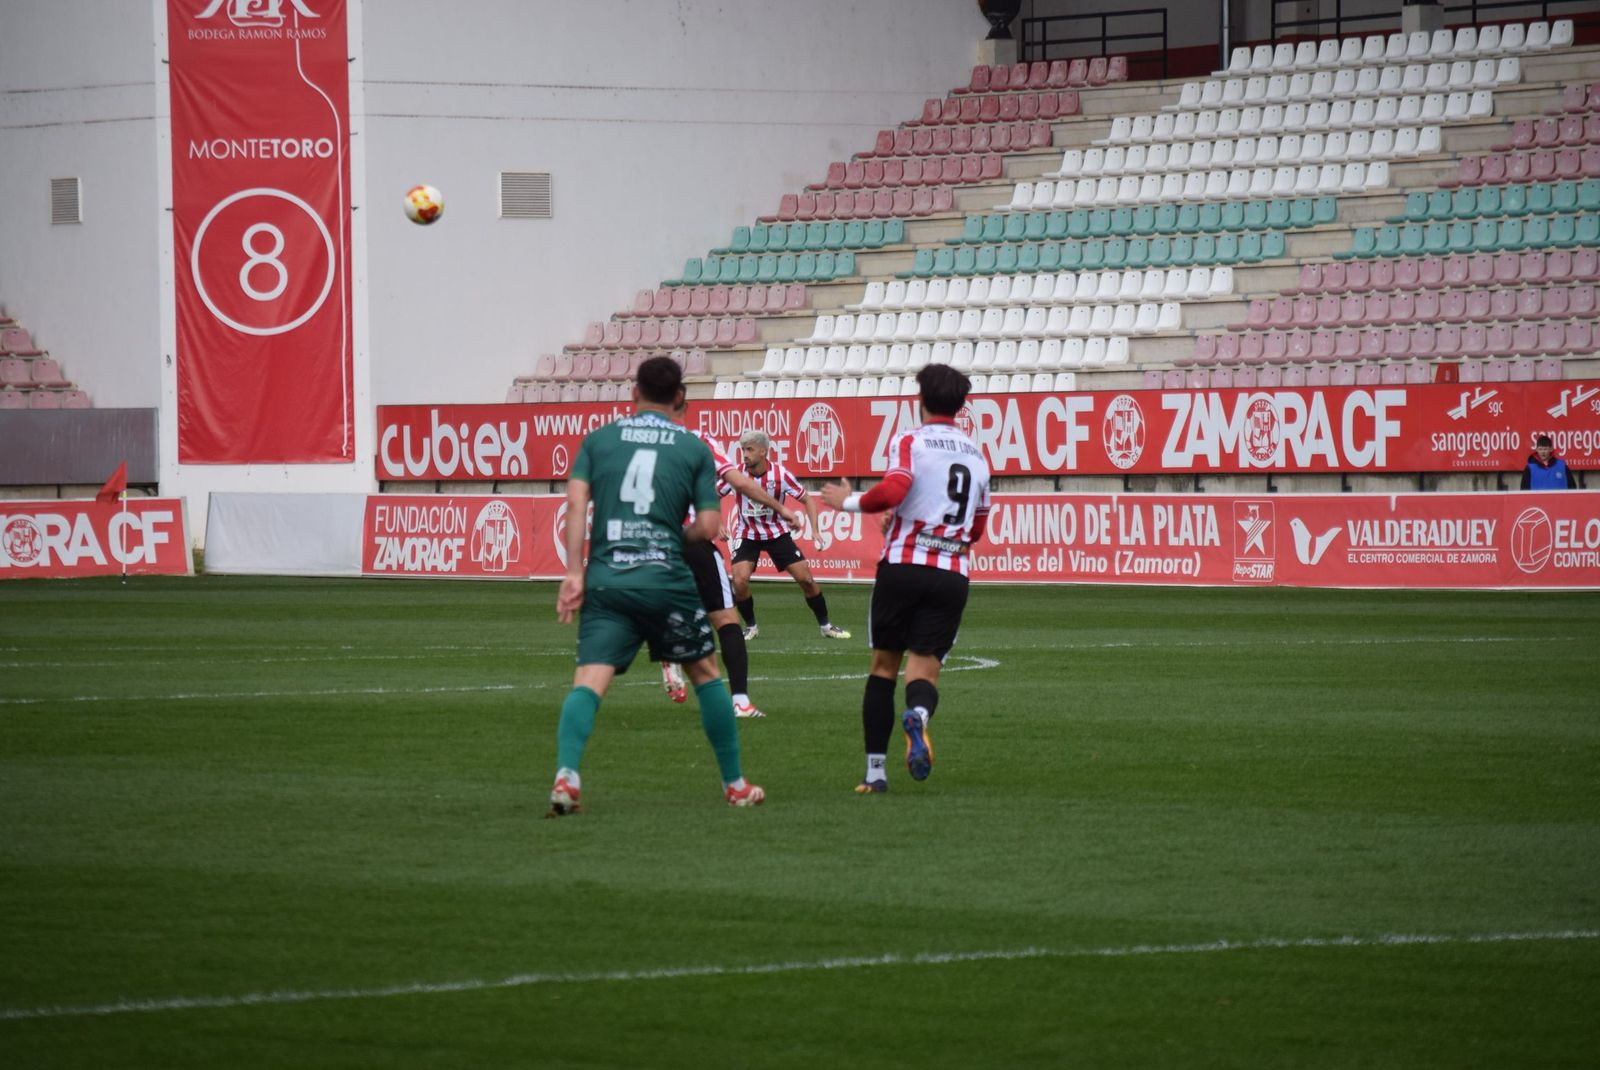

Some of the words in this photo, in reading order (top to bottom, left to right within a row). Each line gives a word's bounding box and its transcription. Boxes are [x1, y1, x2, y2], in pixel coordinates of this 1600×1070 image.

[188, 28, 235, 40] BODEGA
[286, 28, 327, 39] RAMOS
[189, 138, 334, 159] MONTETORO
[239, 222, 288, 301] 8
[698, 403, 790, 437] FUNDACIÓN
[1488, 401, 1504, 416] sgc
[380, 409, 528, 477] cubiex
[1036, 396, 1094, 470] CF
[1161, 391, 1340, 469] ZAMORA
[1342, 389, 1407, 467] CF
[1431, 426, 1520, 458] sangregorio
[619, 448, 658, 515] 4
[943, 463, 972, 526] 9
[374, 500, 467, 534] FUNDACIÓN
[986, 502, 1077, 546] CAMINO
[1084, 504, 1113, 545] DE
[1119, 503, 1147, 547] LA
[1153, 504, 1221, 547] PLATA
[1347, 519, 1497, 547] VALDERADUEY
[108, 511, 173, 564] CF
[823, 559, 861, 569] COMPANY
[1036, 548, 1063, 573] del
[1068, 550, 1108, 573] Vino
[1114, 550, 1201, 577] (Zamora)
[1347, 553, 1357, 563] EL
[1360, 553, 1395, 563] CENTRO
[1397, 553, 1445, 563] COMERCIAL
[1447, 553, 1459, 563] DE
[1460, 553, 1497, 563] ZAMORA
